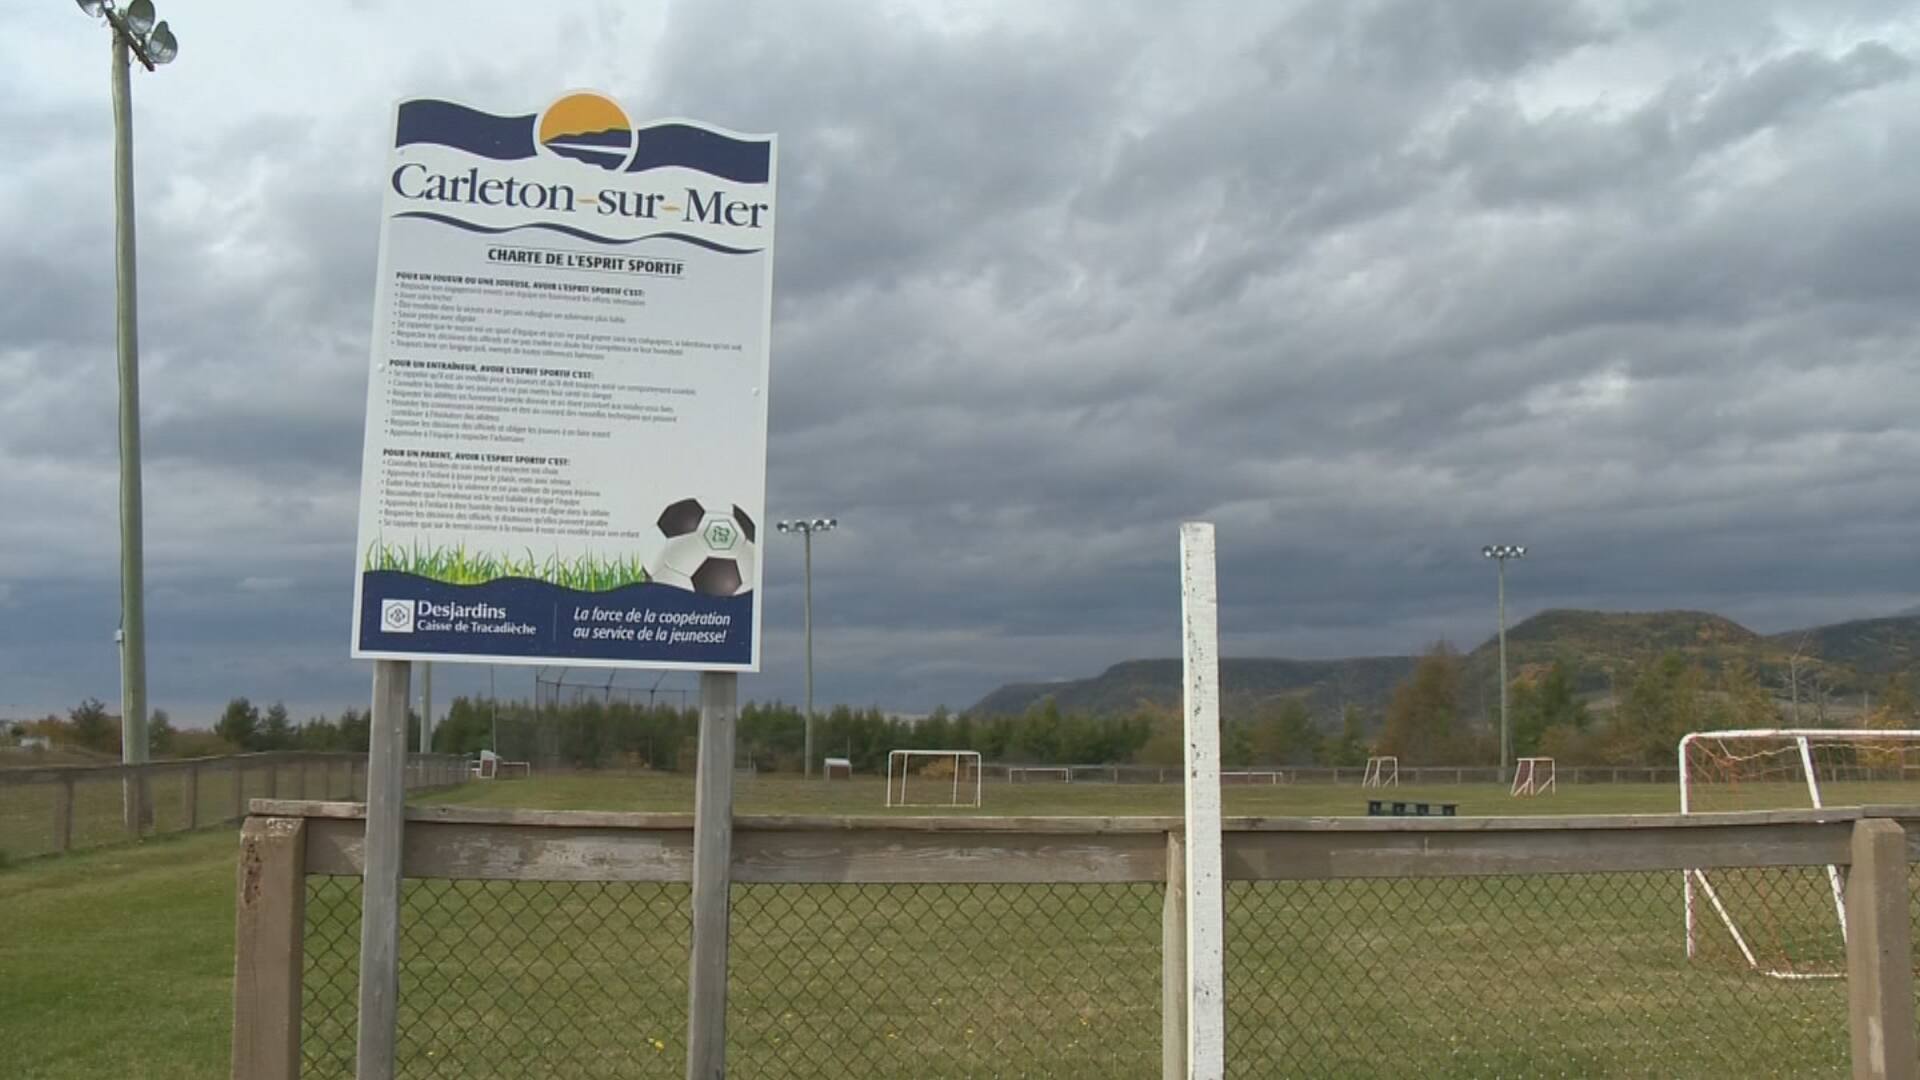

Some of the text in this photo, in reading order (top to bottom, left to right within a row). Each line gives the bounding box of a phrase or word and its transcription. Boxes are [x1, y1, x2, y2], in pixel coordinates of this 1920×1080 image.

[487, 248, 683, 274] CHARTE DE L'ESPRIT SPORTIF
[396, 271, 418, 279] POUR
[432, 274, 463, 283] JOUEUR
[464, 276, 476, 284] OU
[477, 277, 494, 285] UNE
[532, 281, 557, 290] AVOIR
[557, 283, 589, 292] L'ESPRIT
[590, 286, 621, 294] SPORTIF
[389, 358, 411, 367] POUR
[412, 360, 425, 368] UN
[425, 361, 479, 371] ENTRAÎNEUR,
[479, 364, 504, 373] AVOIR
[505, 366, 538, 375] L'ESPRIT
[539, 368, 570, 377] SPORTIF
[383, 448, 405, 456] POUR
[419, 450, 454, 459] PARENT,
[454, 452, 479, 461] AVOIR
[480, 454, 513, 462] L'ESPRIT
[514, 456, 546, 464] SPORTIF
[418, 600, 506, 620] Desjardins
[574, 606, 731, 626] La force de la coopération
[417, 619, 537, 635] Caisse de Tracadièche
[573, 626, 727, 645] au service de la jeunesse!
